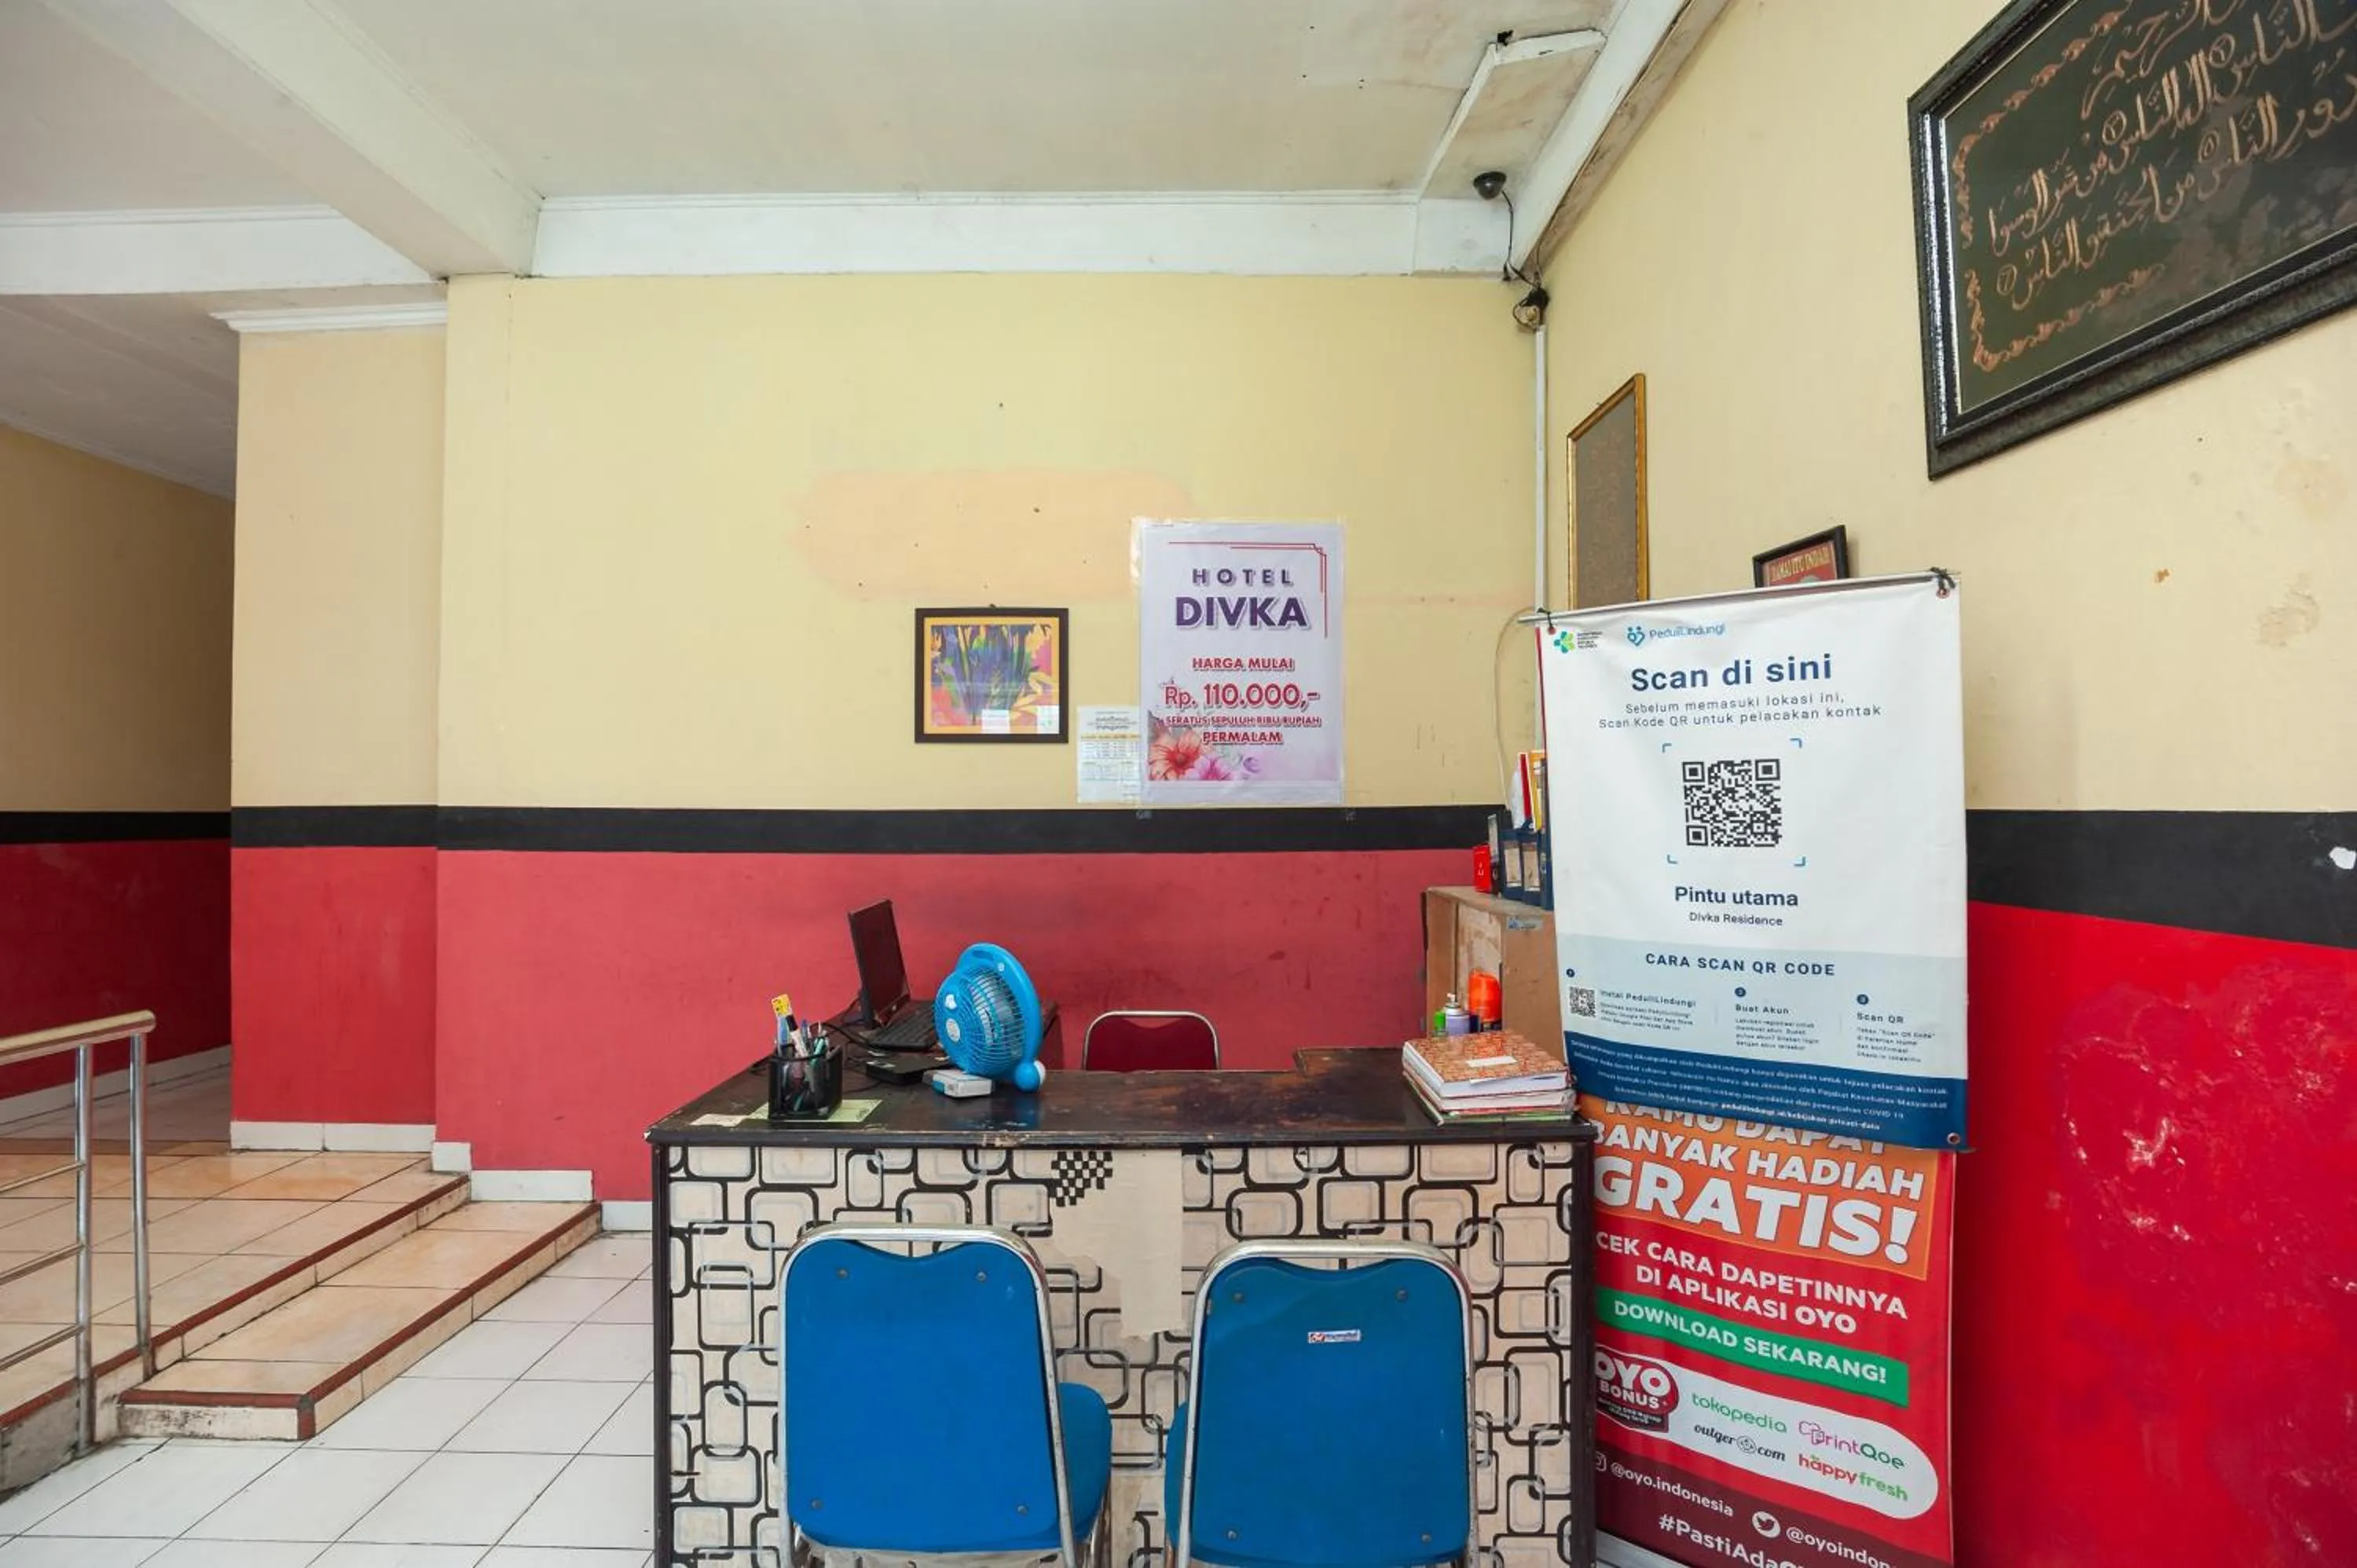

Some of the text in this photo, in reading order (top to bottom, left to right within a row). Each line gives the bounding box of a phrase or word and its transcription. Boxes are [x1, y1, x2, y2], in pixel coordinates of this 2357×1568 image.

[1193, 569, 1293, 586] HOTEL
[1175, 596, 1310, 628] DIVKA
[1193, 658, 1296, 672] HARGA MULAI
[1631, 653, 1831, 691] Scan di sini
[1165, 686, 1197, 711] Rp.
[1626, 691, 1845, 714] Sebelum memasuki lokasi ini,
[1599, 705, 1882, 728] Scan Kode QR untuk pelacakan kontak
[1203, 731, 1284, 745] PERMALAM
[1674, 886, 1798, 907] Pintu utama
[1690, 911, 1783, 926] Divka Residence
[1645, 952, 1835, 976] CARA SCAN QR CODE
[1762, 1006, 1789, 1014] Akun
[1857, 1012, 1904, 1024] Scan QR
[1746, 1149, 1925, 1201] HADIAH
[1595, 1155, 1918, 1265] GRATIS!
[1596, 1231, 1908, 1320] CEK CARA DAPETINNYA
[1637, 1264, 1857, 1333] DI APLIKASI OYO
[1614, 1300, 1887, 1383] DOWNLOAD SEKARANG!
[1595, 1350, 1671, 1397] OYO
[1599, 1379, 1660, 1409] BONUS
[1692, 1393, 1788, 1434] tokopedia
[1611, 1463, 1734, 1518] @oyo.indonesia
